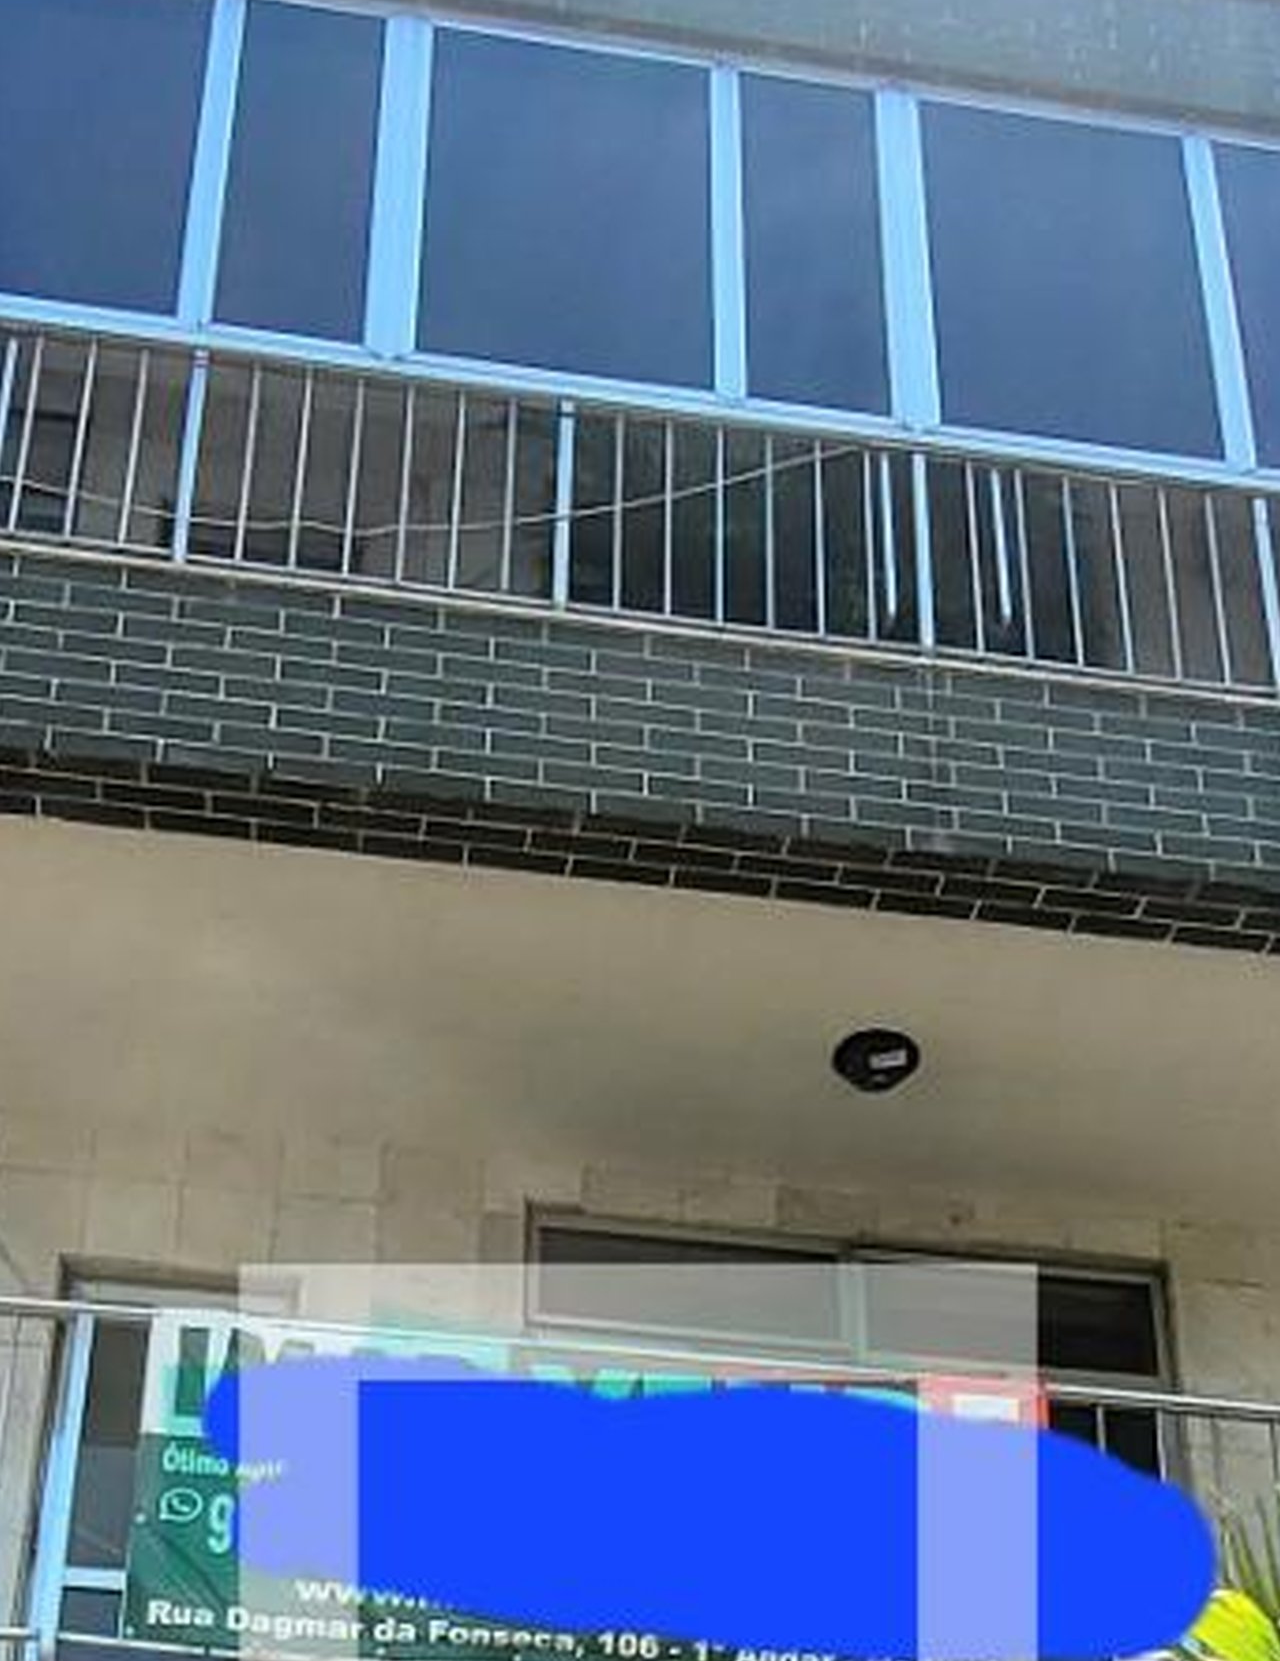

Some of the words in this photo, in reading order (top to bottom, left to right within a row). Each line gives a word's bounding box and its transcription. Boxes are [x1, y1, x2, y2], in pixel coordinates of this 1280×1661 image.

[147, 1600, 214, 1627] Rua
[227, 1607, 363, 1640] Dagmar
[374, 1616, 416, 1642] da
[428, 1620, 584, 1658] Fonseca,
[598, 1632, 658, 1658] 106
